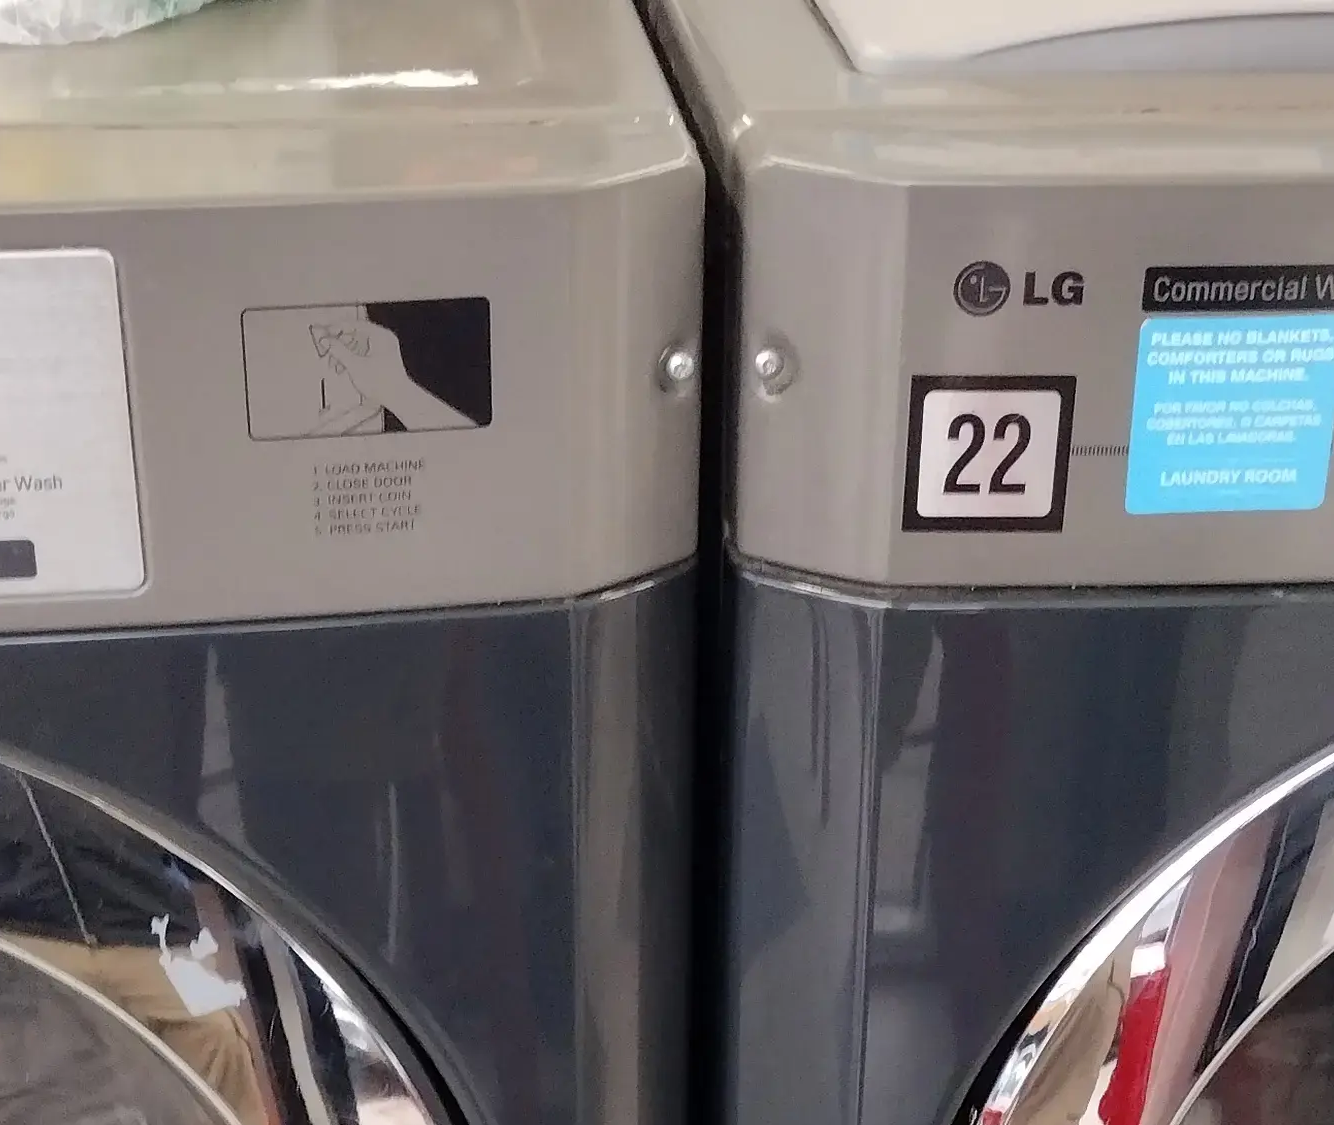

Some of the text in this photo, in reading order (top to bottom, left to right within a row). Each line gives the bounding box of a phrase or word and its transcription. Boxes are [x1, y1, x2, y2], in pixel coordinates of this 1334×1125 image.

[1023, 271, 1085, 306] LG
[1153, 275, 1308, 302] Commercial
[1151, 332, 1213, 346] PLEASE
[1217, 331, 1242, 345] NO
[1147, 347, 1334, 366] COMFORTERS OR RUGS
[1168, 370, 1185, 384] IN
[1190, 370, 1226, 383] THIS
[943, 413, 1031, 495] 22
[15, 475, 63, 492] Wash
[1161, 468, 1297, 486] LAUNDRY ROOM
